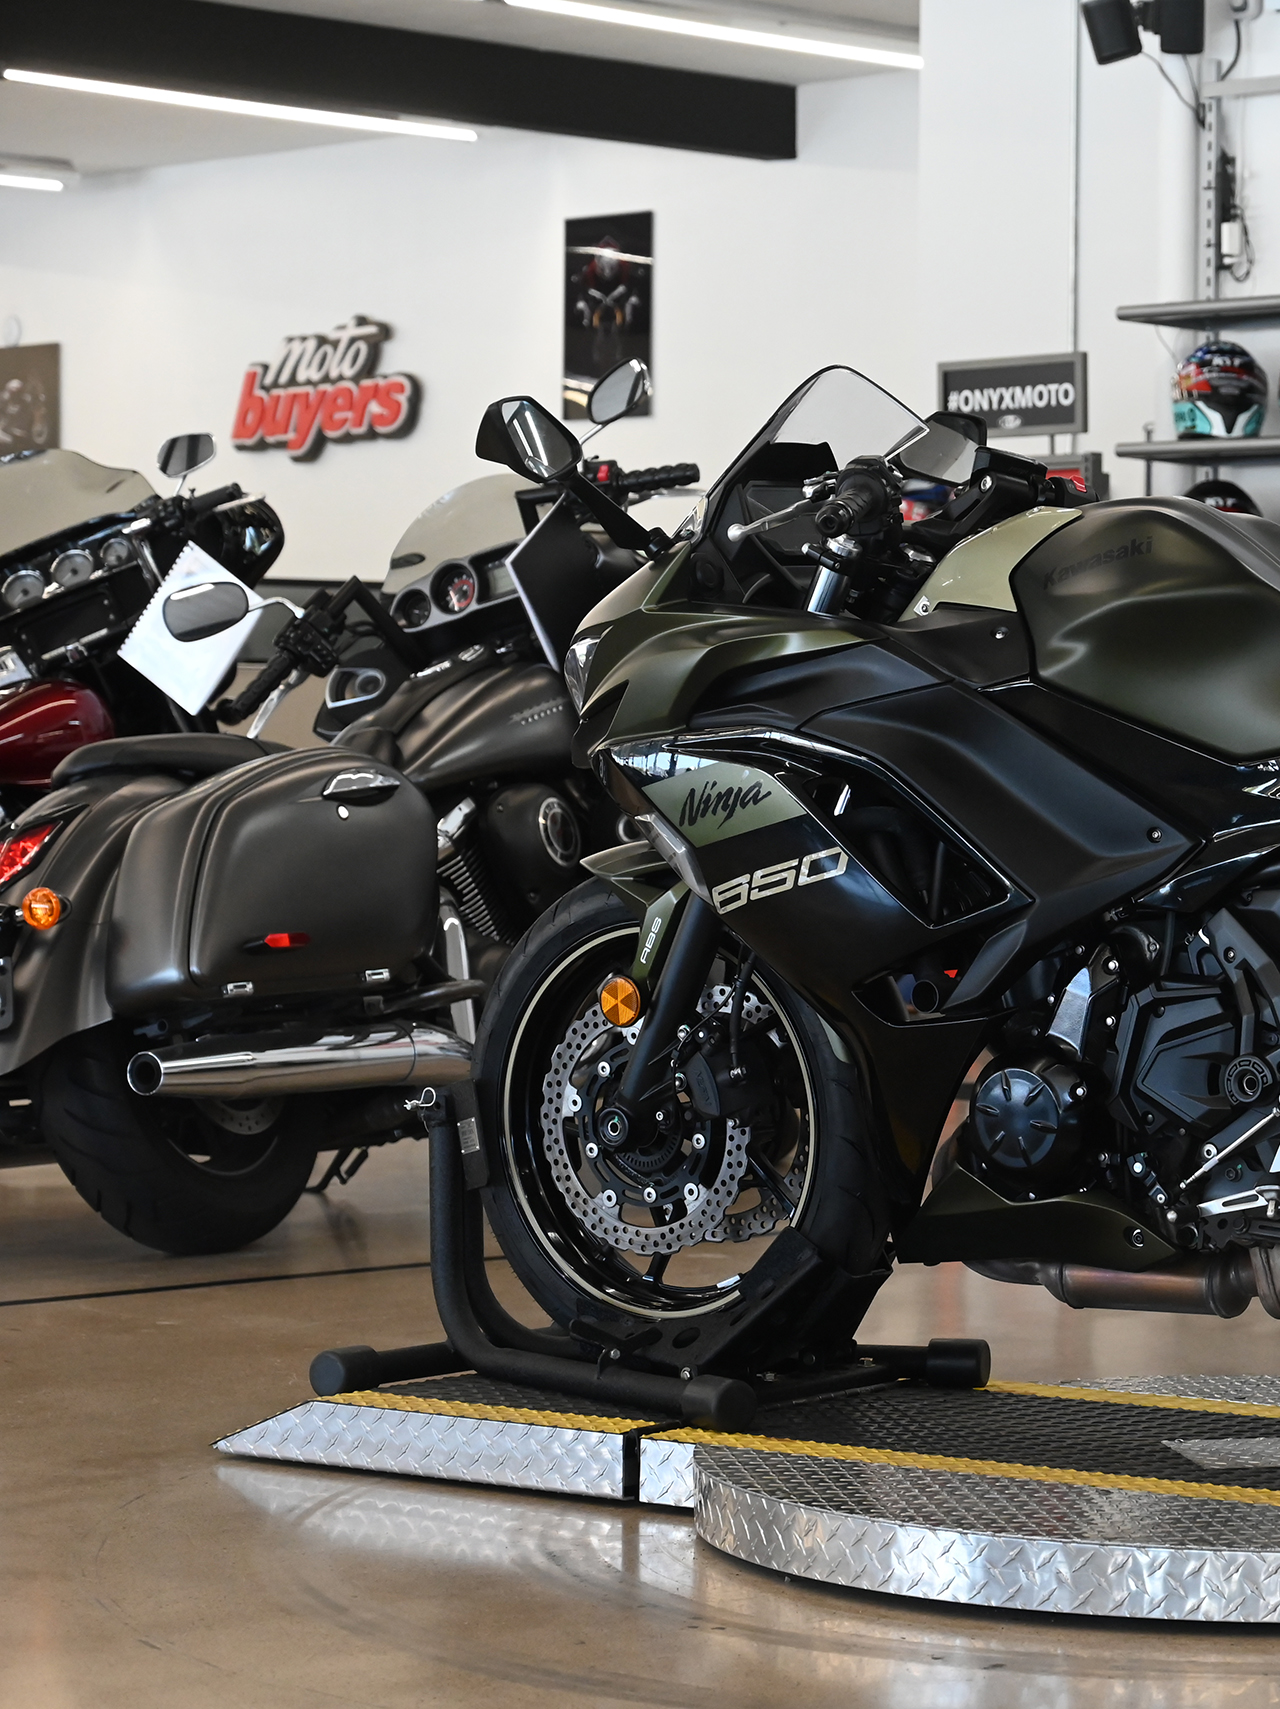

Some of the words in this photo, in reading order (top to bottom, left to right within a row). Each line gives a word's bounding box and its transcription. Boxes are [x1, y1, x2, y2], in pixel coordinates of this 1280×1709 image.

[231, 366, 410, 456] buyers
[947, 382, 1076, 413] #ONYXMOTO
[1043, 536, 1153, 590] Kawasaki
[679, 780, 772, 829] Ninja
[712, 846, 849, 915] 650
[640, 916, 662, 964] ABS
